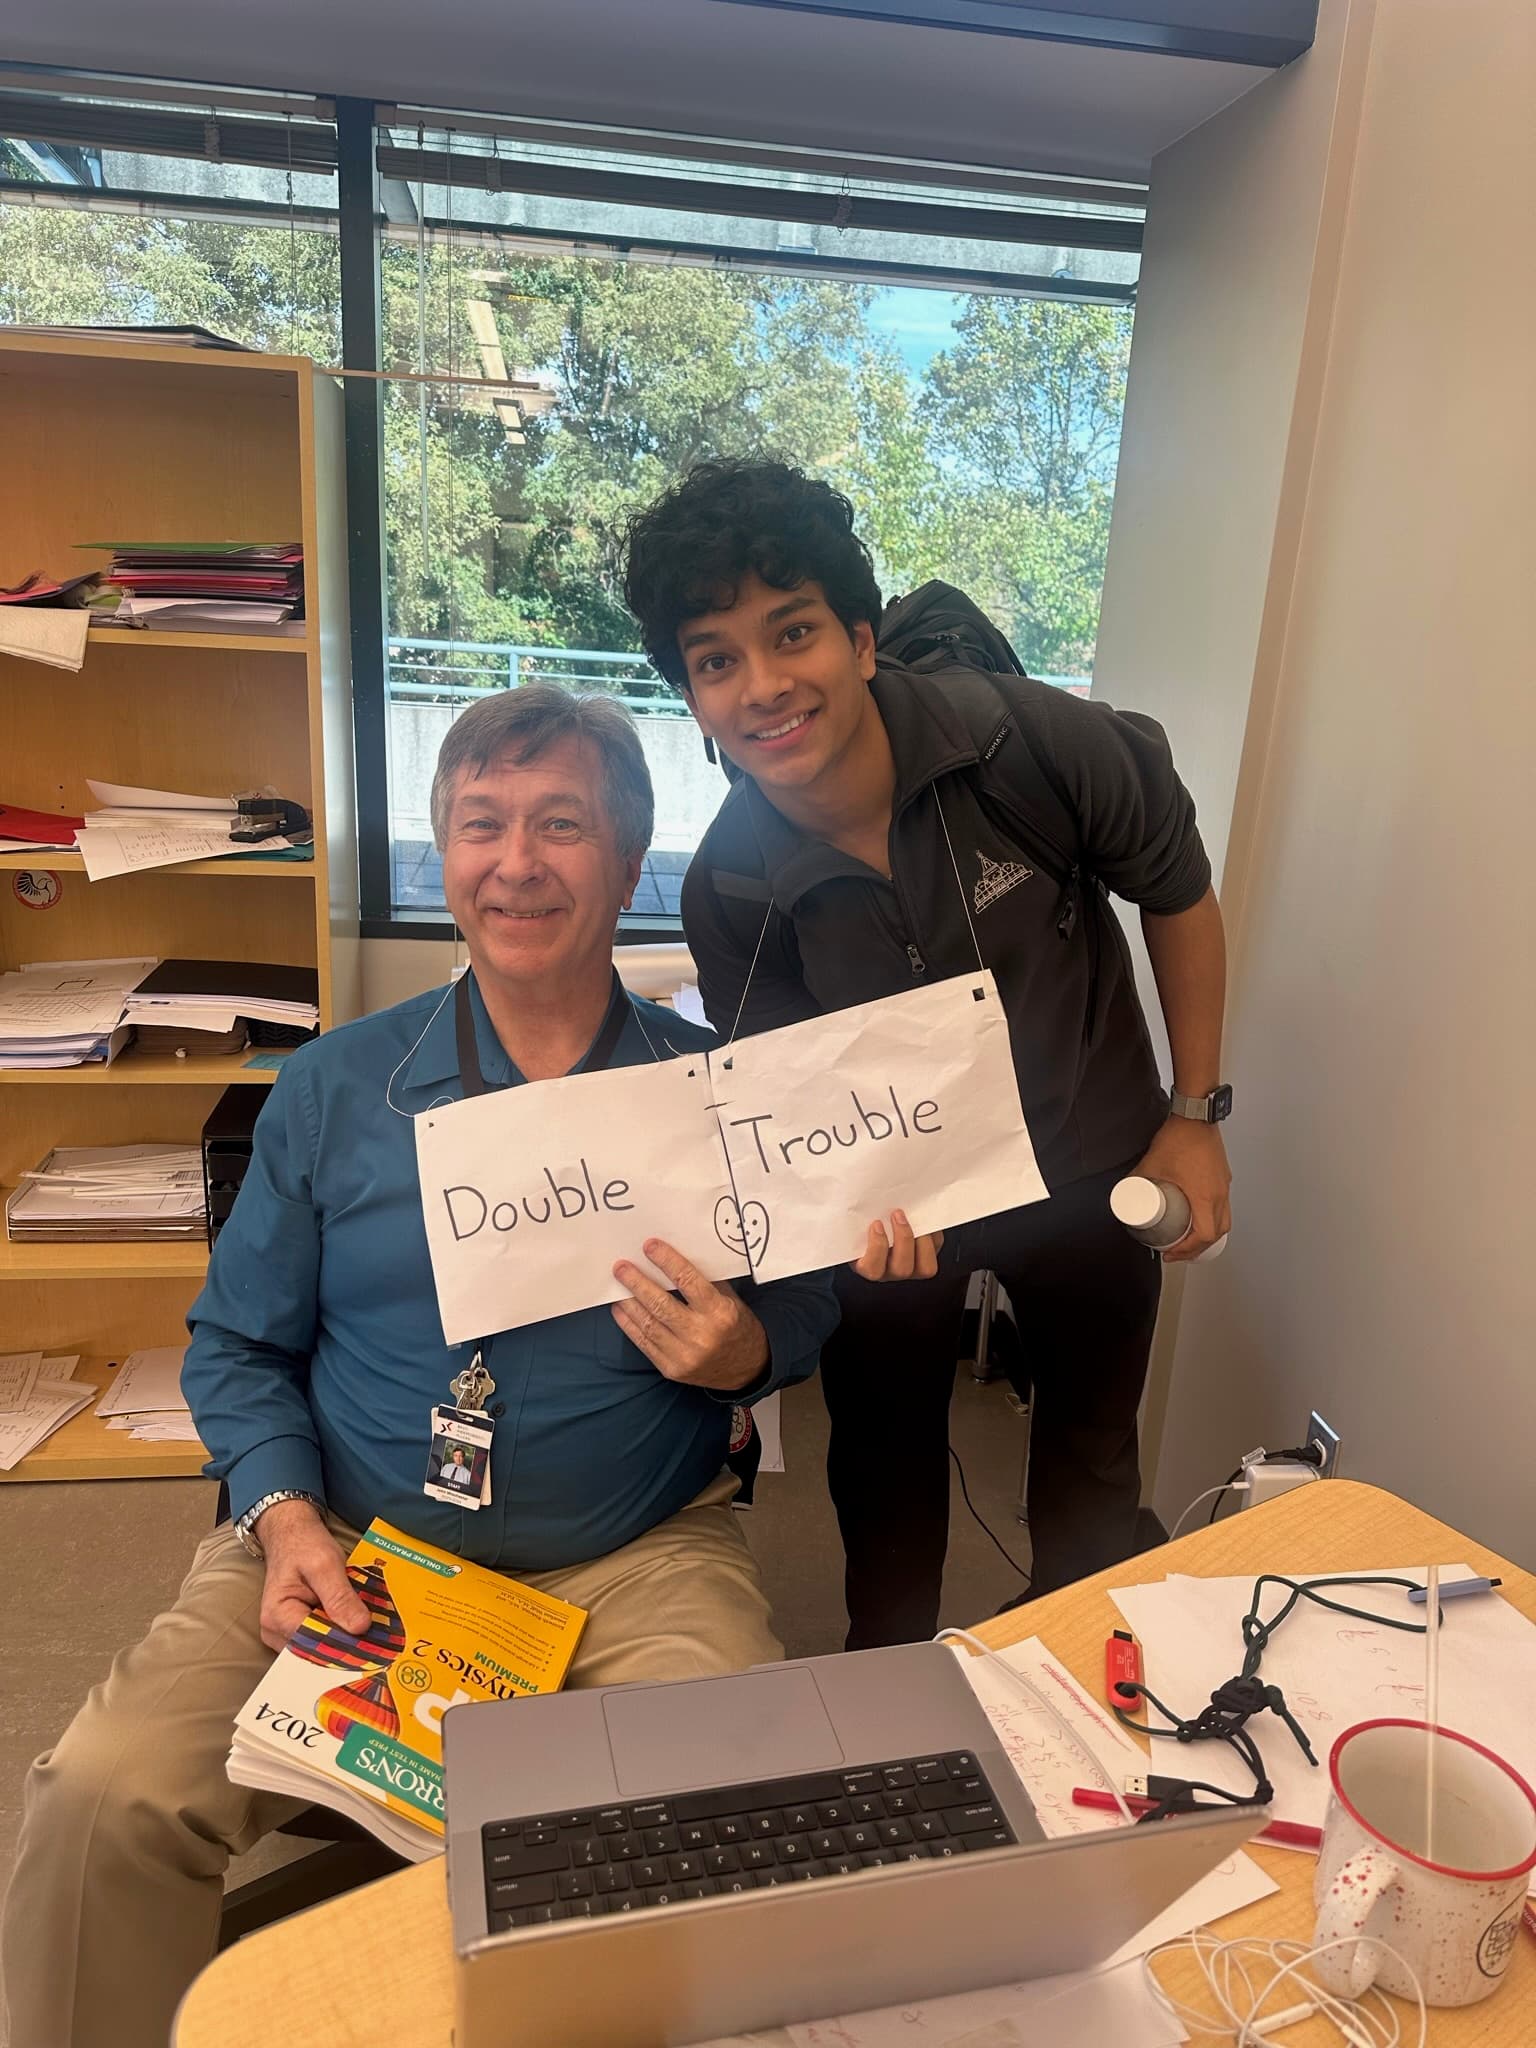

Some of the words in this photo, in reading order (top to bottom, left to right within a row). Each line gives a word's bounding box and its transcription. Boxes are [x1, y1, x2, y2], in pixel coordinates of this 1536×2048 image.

[984, 726, 1008, 760] NOMATIC
[443, 1158, 635, 1242] Double
[730, 1085, 943, 1174] Trouble
[373, 1535, 413, 1559] PRACTICE
[411, 1554, 441, 1571] ONLINE
[412, 1639, 433, 1658] 2
[436, 1648, 516, 1700] hysics
[474, 1650, 540, 1694] PREMIUM
[255, 1702, 325, 1748] 2024
[368, 1738, 389, 1752] PREP
[390, 1750, 408, 1763] TEST
[356, 1747, 446, 1811] RRON'S
[418, 1764, 442, 1782] NAME
